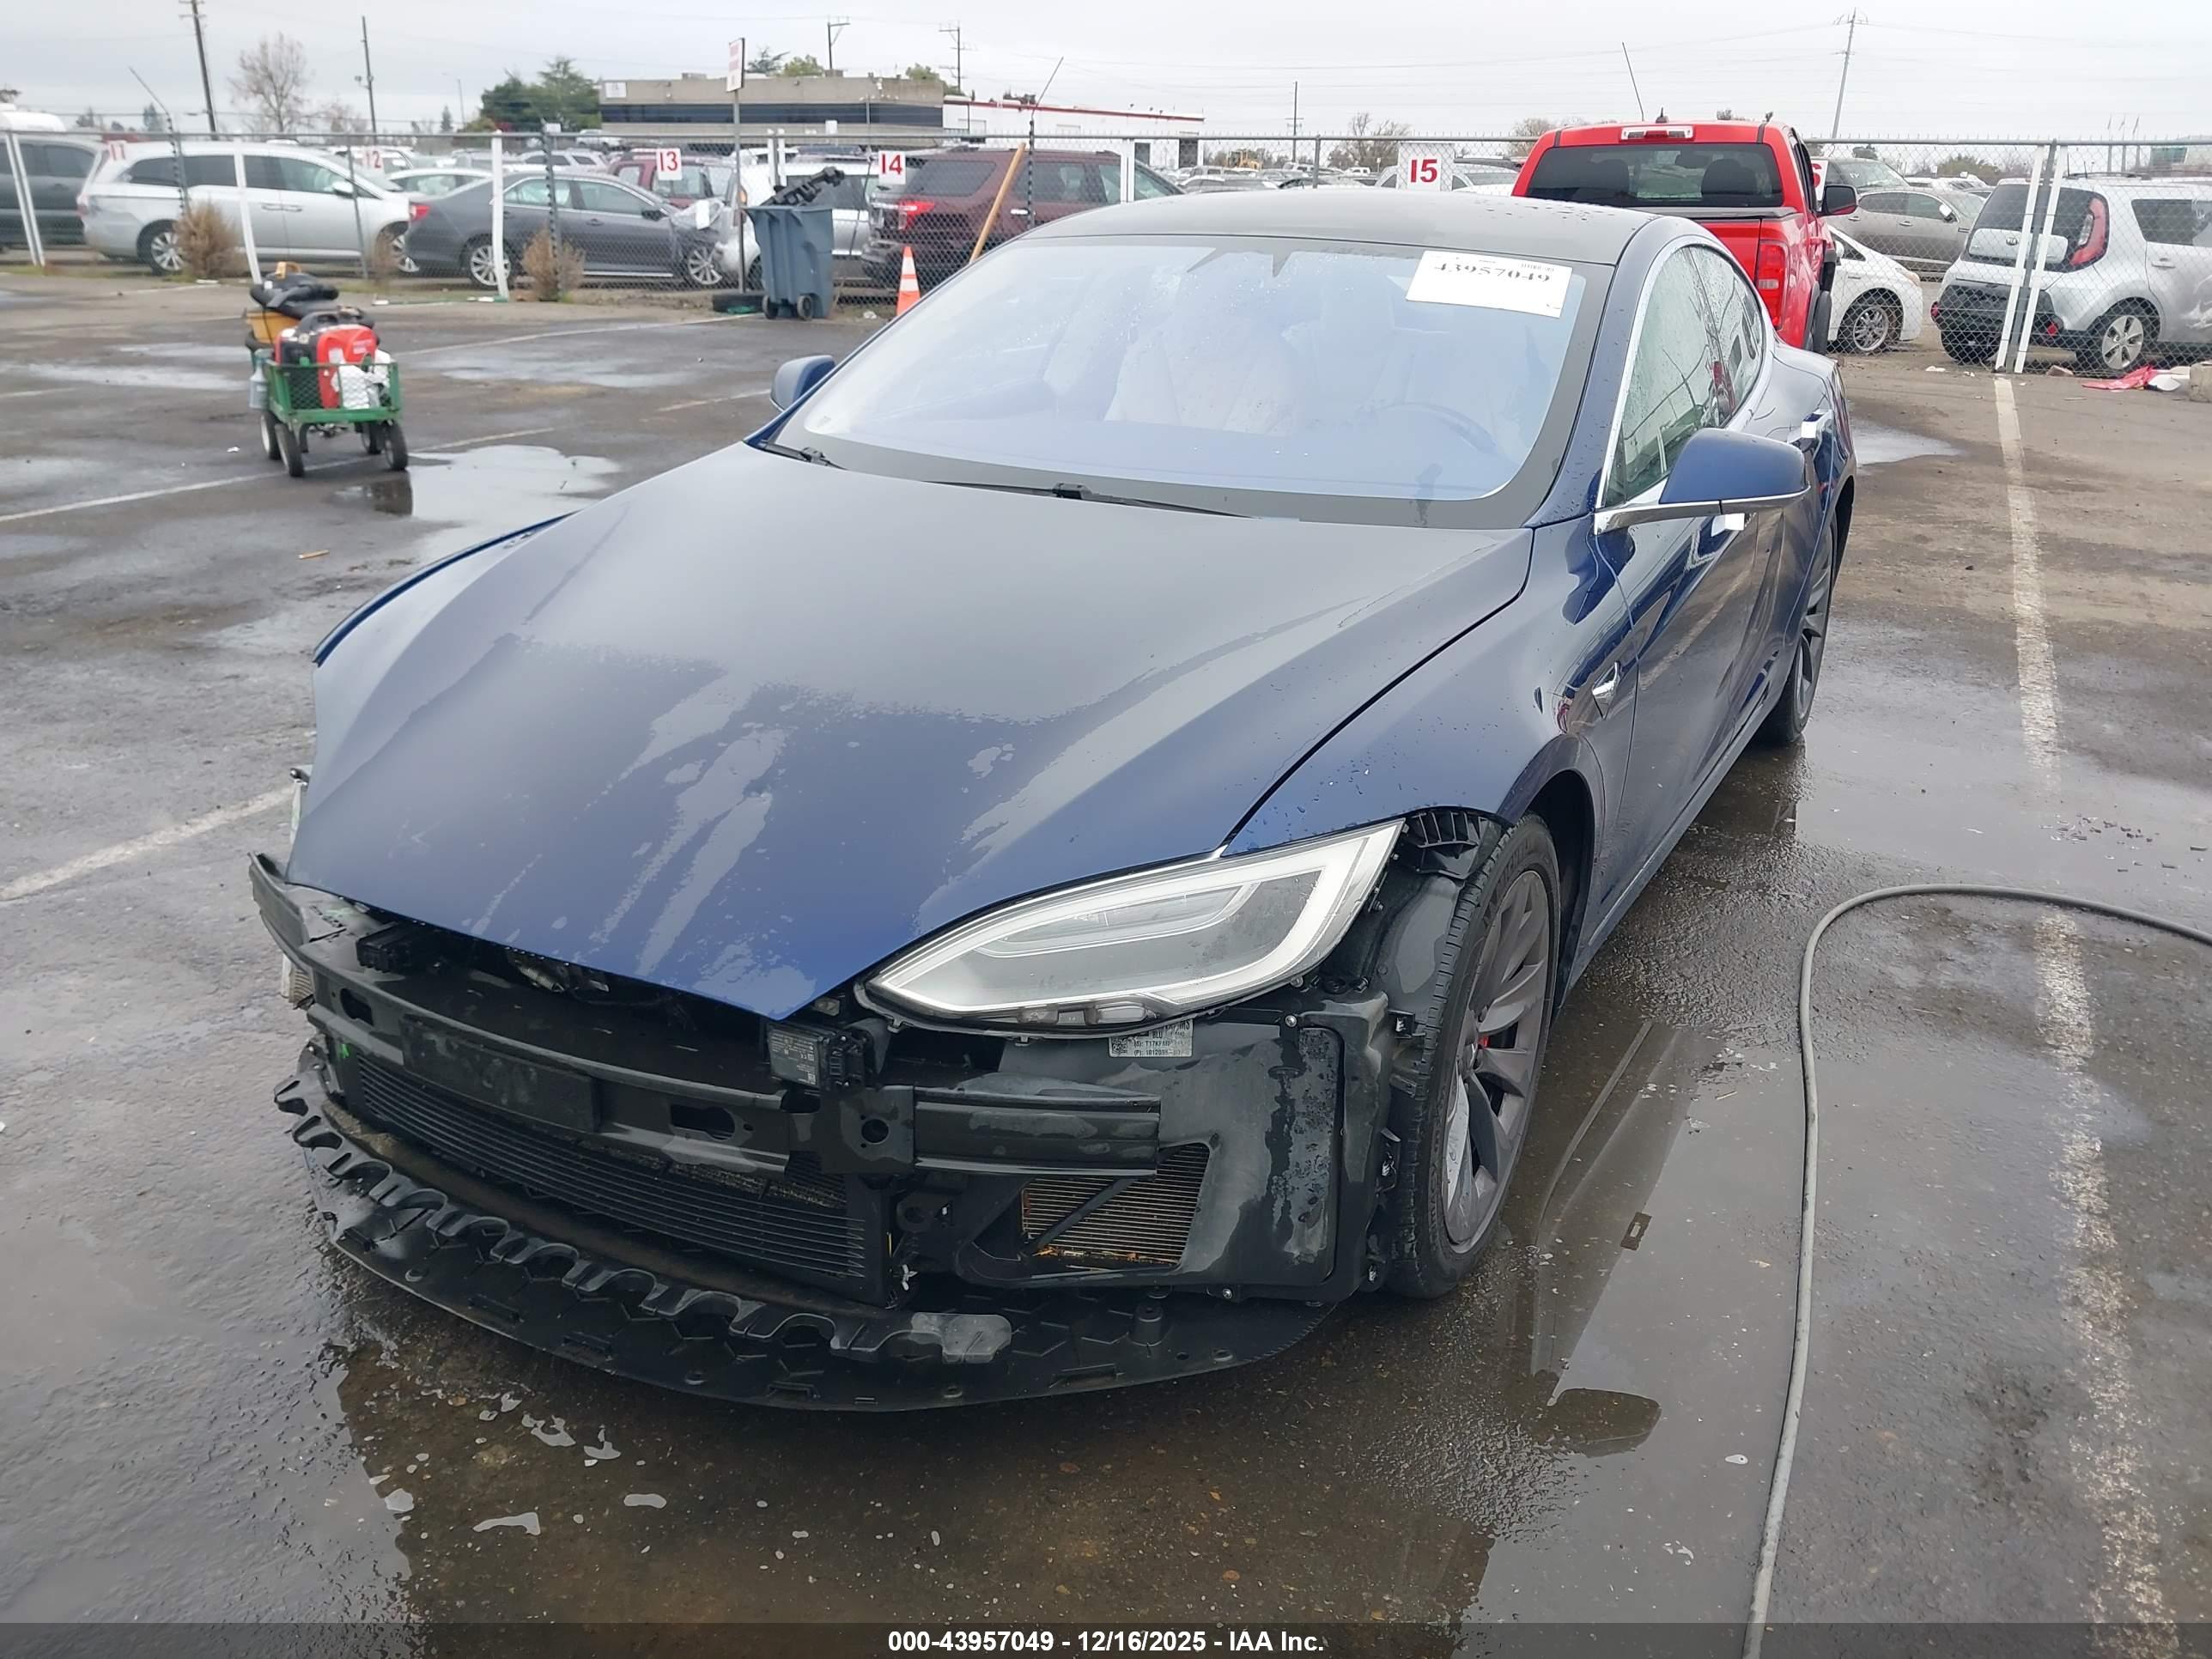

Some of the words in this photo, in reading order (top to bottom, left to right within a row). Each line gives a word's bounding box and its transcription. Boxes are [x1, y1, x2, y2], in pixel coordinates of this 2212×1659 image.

[366, 150, 382, 168] 12
[659, 151, 678, 172] 13
[882, 154, 903, 175] 14
[1410, 158, 1438, 184] 15
[1434, 263, 1550, 283] 43957049
